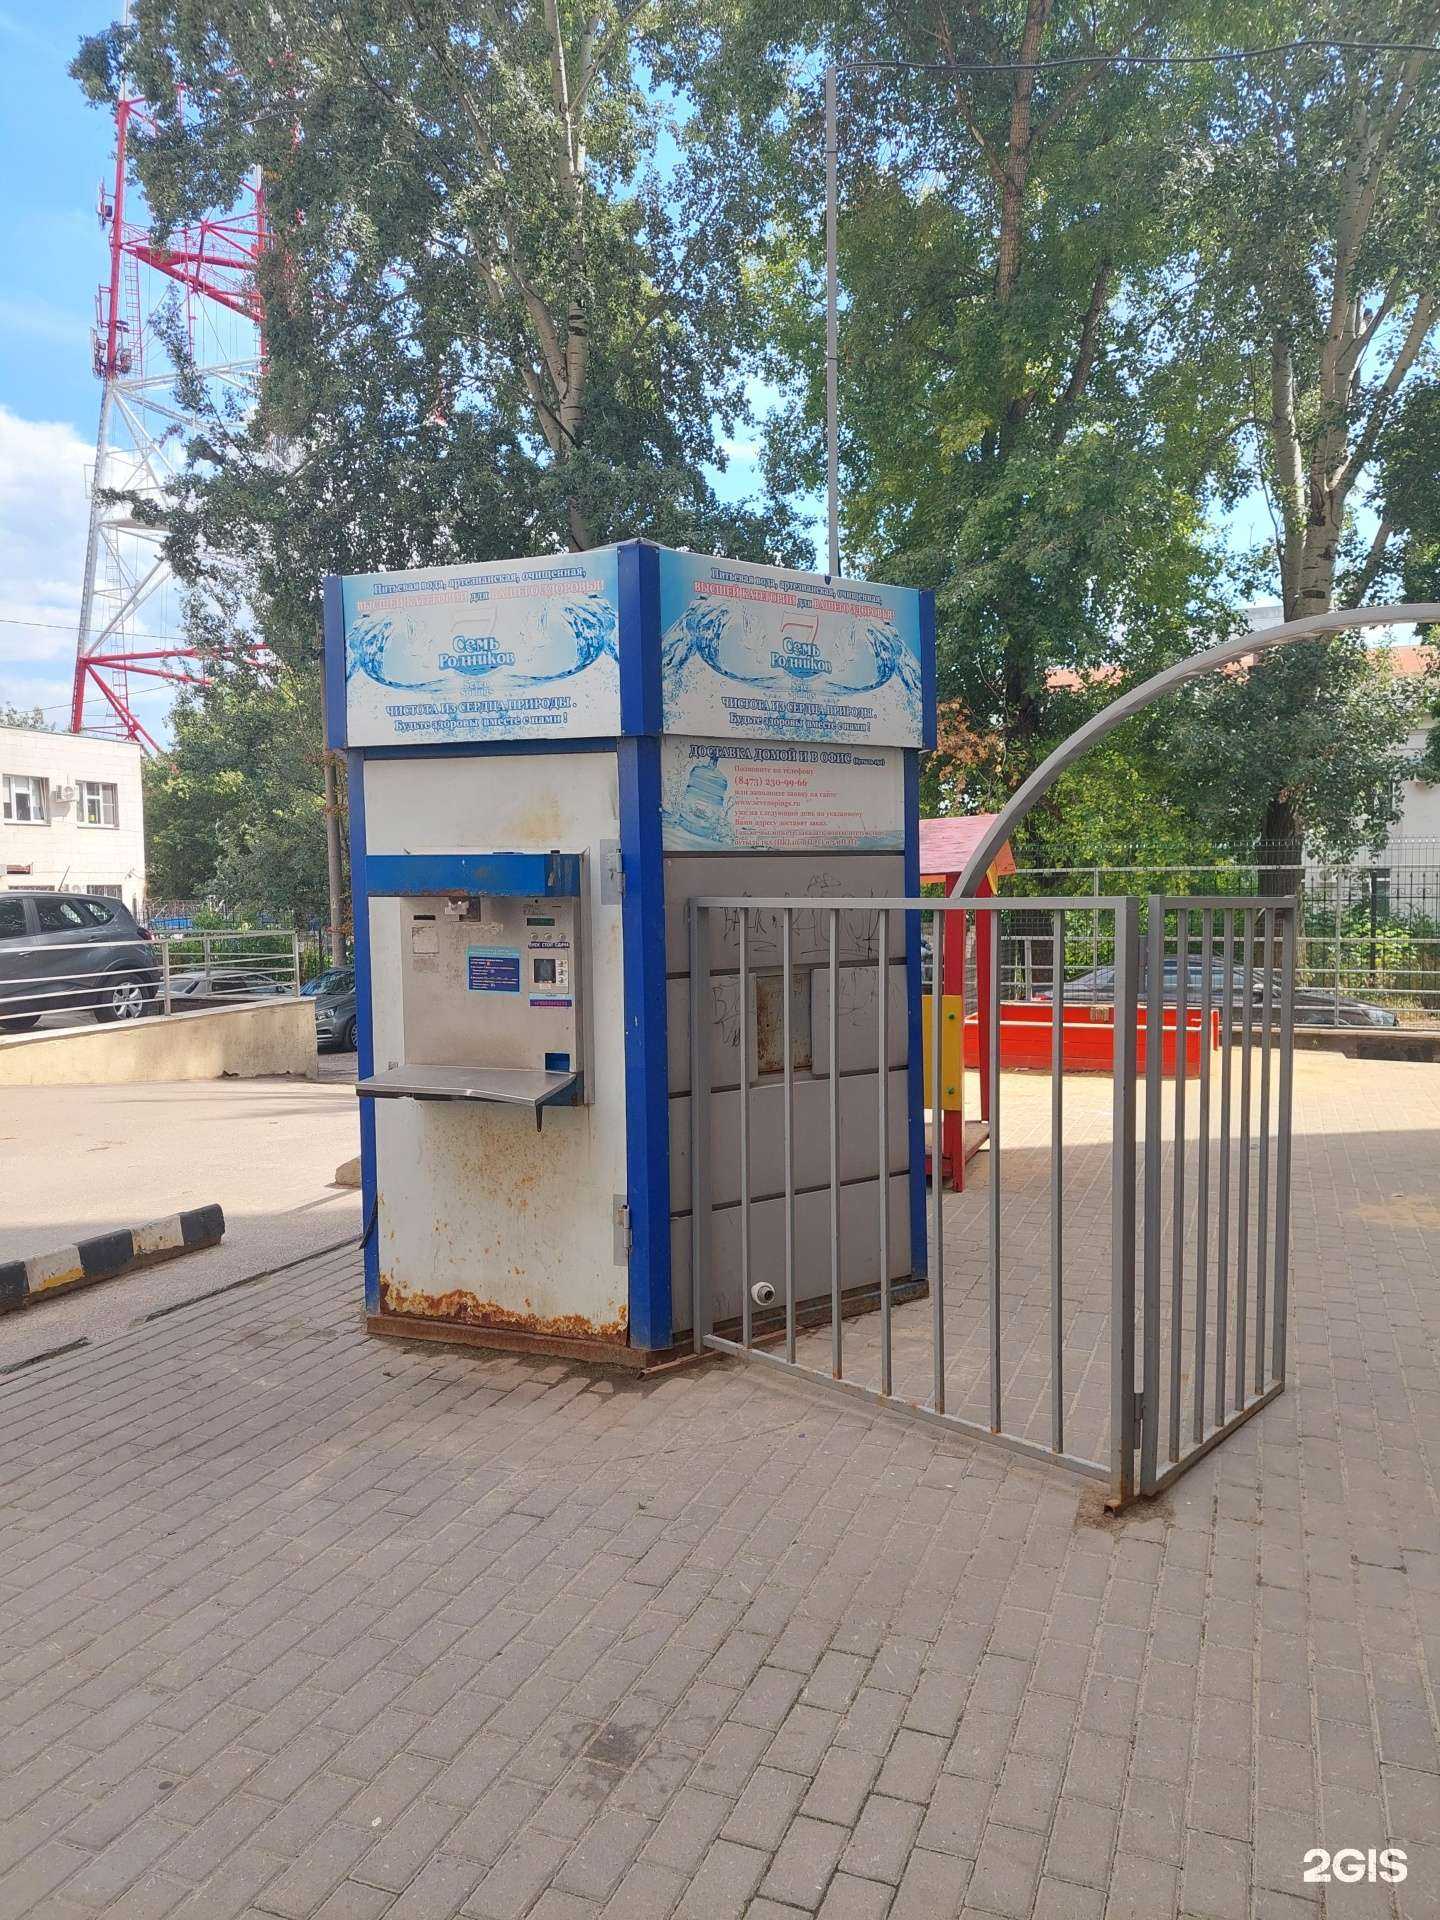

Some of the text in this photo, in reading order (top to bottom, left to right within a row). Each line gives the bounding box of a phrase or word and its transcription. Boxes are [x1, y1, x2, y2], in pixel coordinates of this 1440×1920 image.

[373, 582, 419, 595] Питьевая
[521, 566, 587, 581] очищенная,
[452, 635, 500, 654] Семь
[782, 637, 820, 659] Семь
[438, 652, 517, 671] Родников
[770, 651, 832, 674] Родников
[385, 703, 440, 717] ЧИСТОТА
[458, 699, 507, 713] СЕРДЦА
[721, 697, 769, 711] ЧИСТОТА
[482, 717, 520, 727] вместе
[689, 744, 753, 759] ДОСТАВКА
[753, 747, 798, 762] ДОМОЙ
[820, 752, 852, 764] ОФИС
